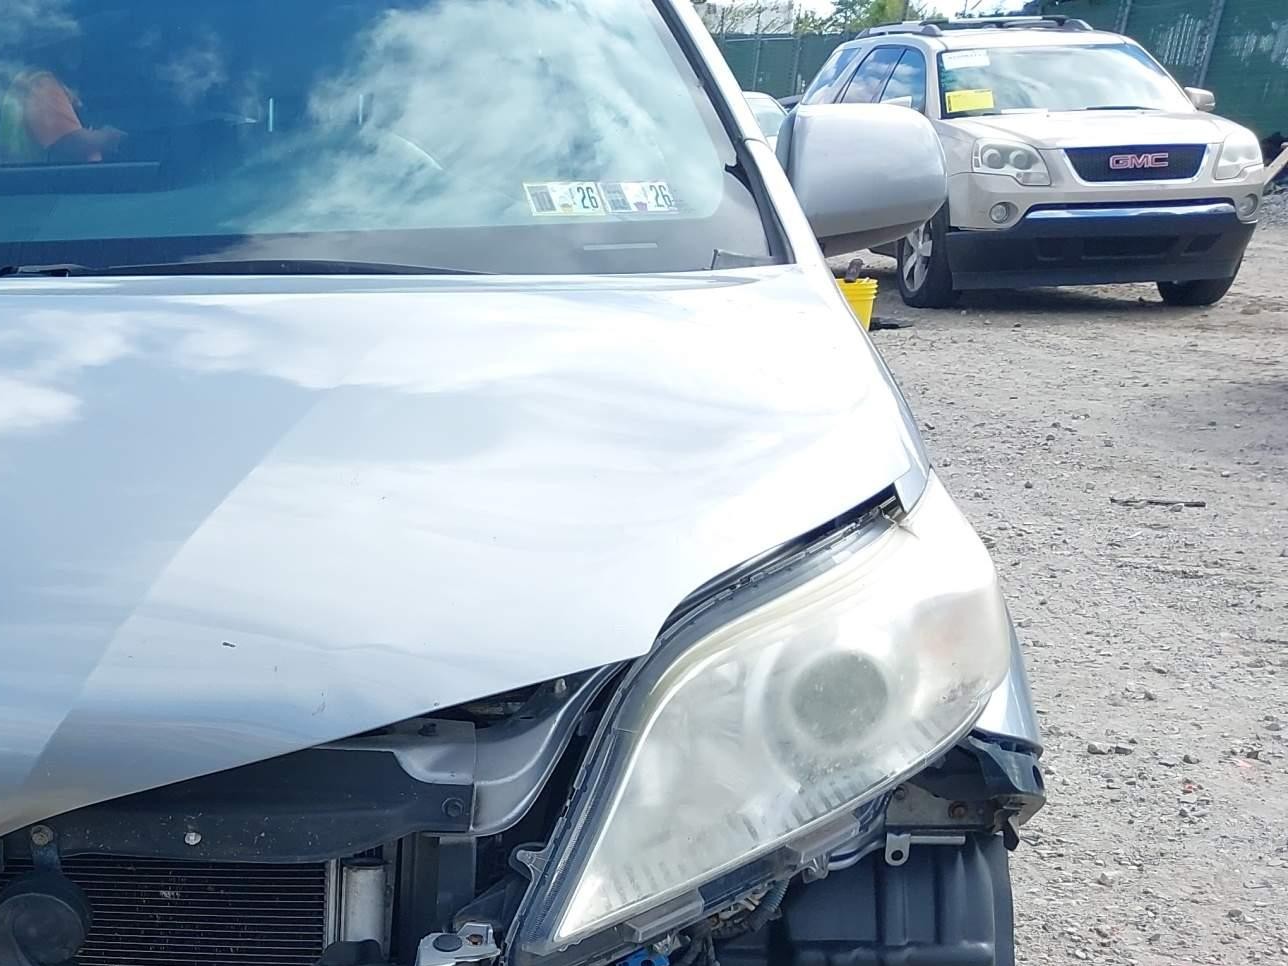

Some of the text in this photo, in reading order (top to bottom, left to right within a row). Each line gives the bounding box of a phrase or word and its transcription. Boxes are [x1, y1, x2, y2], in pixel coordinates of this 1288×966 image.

[1109, 152, 1169, 170] GMC
[576, 186, 599, 209] 26
[649, 184, 674, 208] 26
